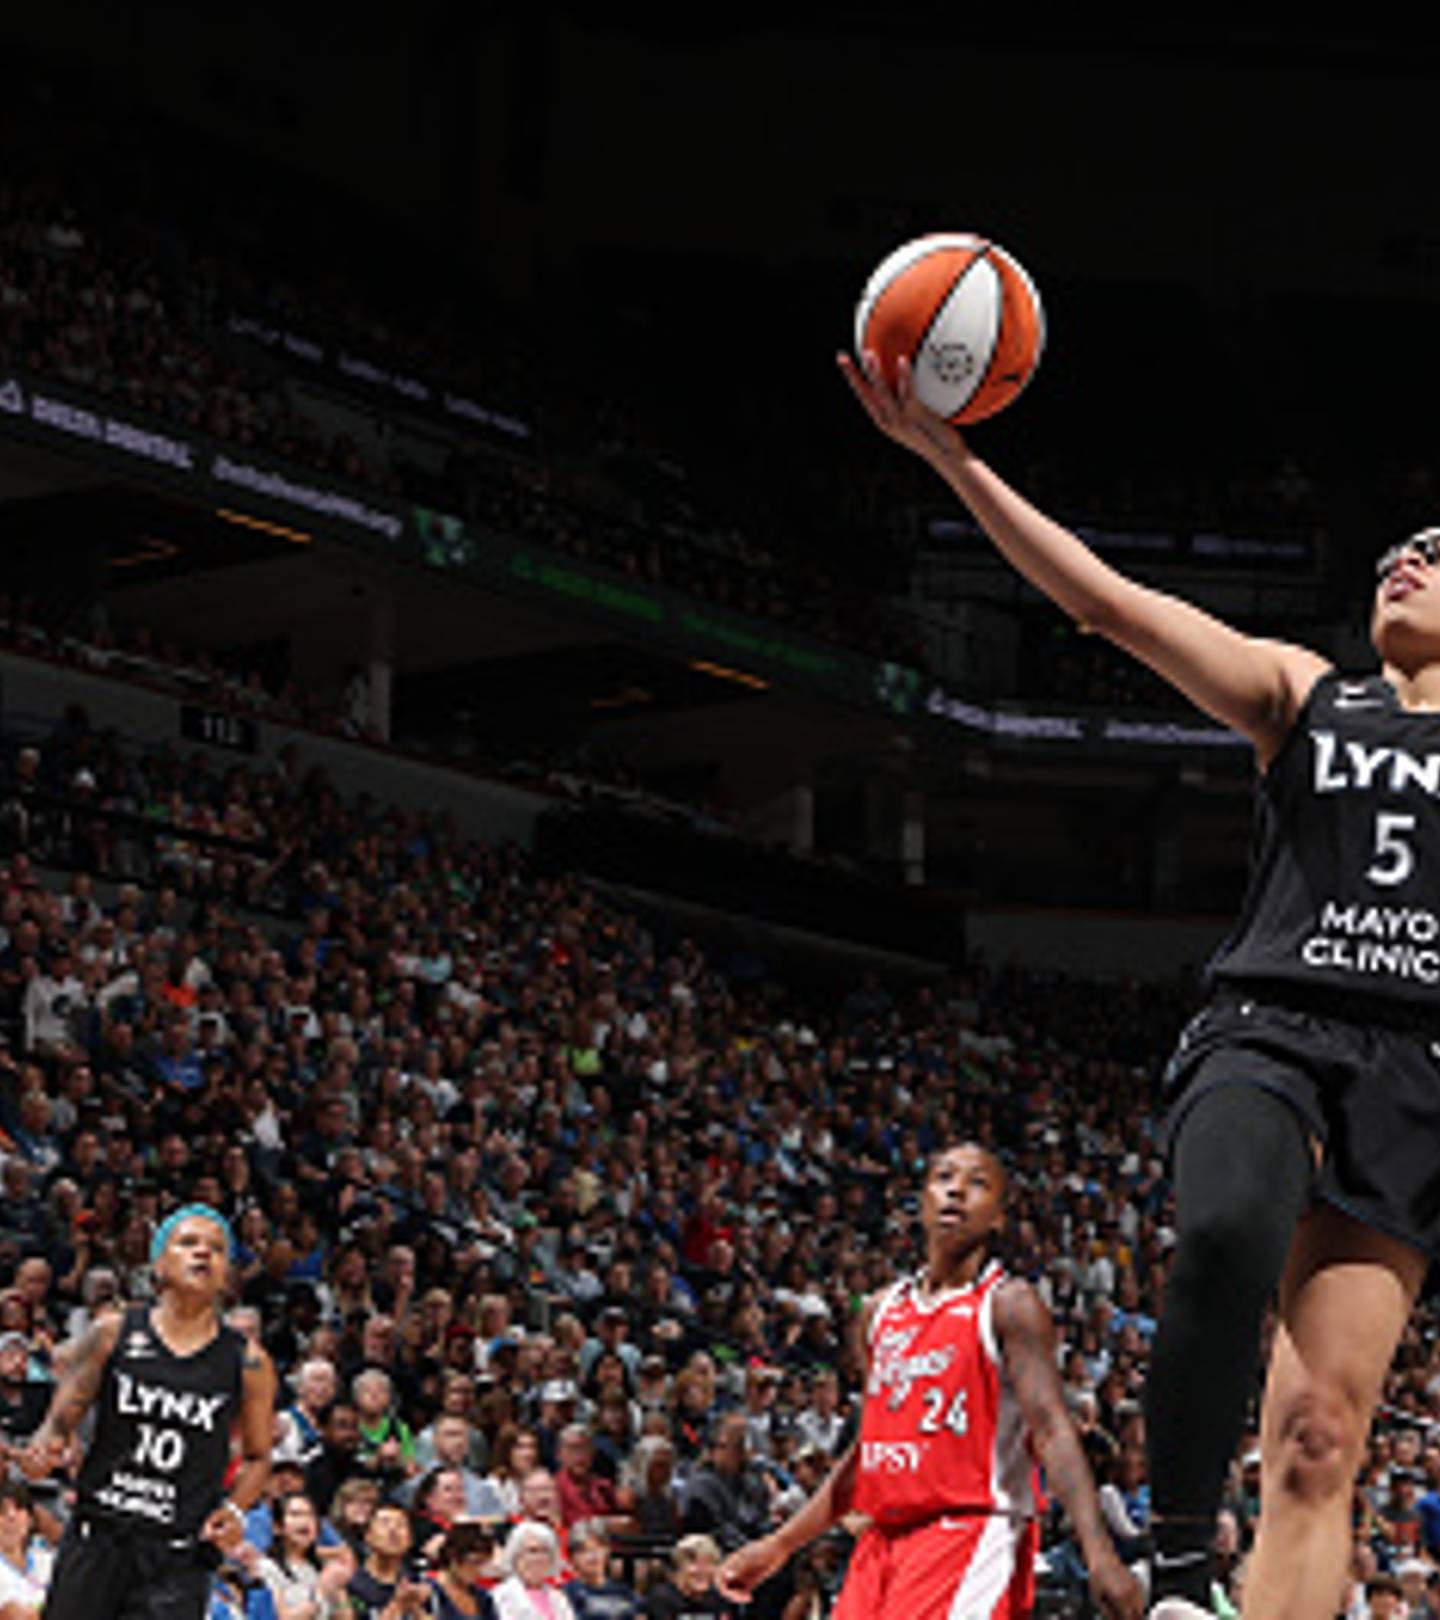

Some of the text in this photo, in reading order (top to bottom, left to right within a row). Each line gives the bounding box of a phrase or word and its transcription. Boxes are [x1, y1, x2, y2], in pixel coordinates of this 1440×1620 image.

[1364, 809, 1416, 888] 5
[1319, 901, 1440, 942] MAYO
[113, 1369, 232, 1433] LYNX
[918, 1385, 970, 1436] 24
[133, 1422, 186, 1473] 10
